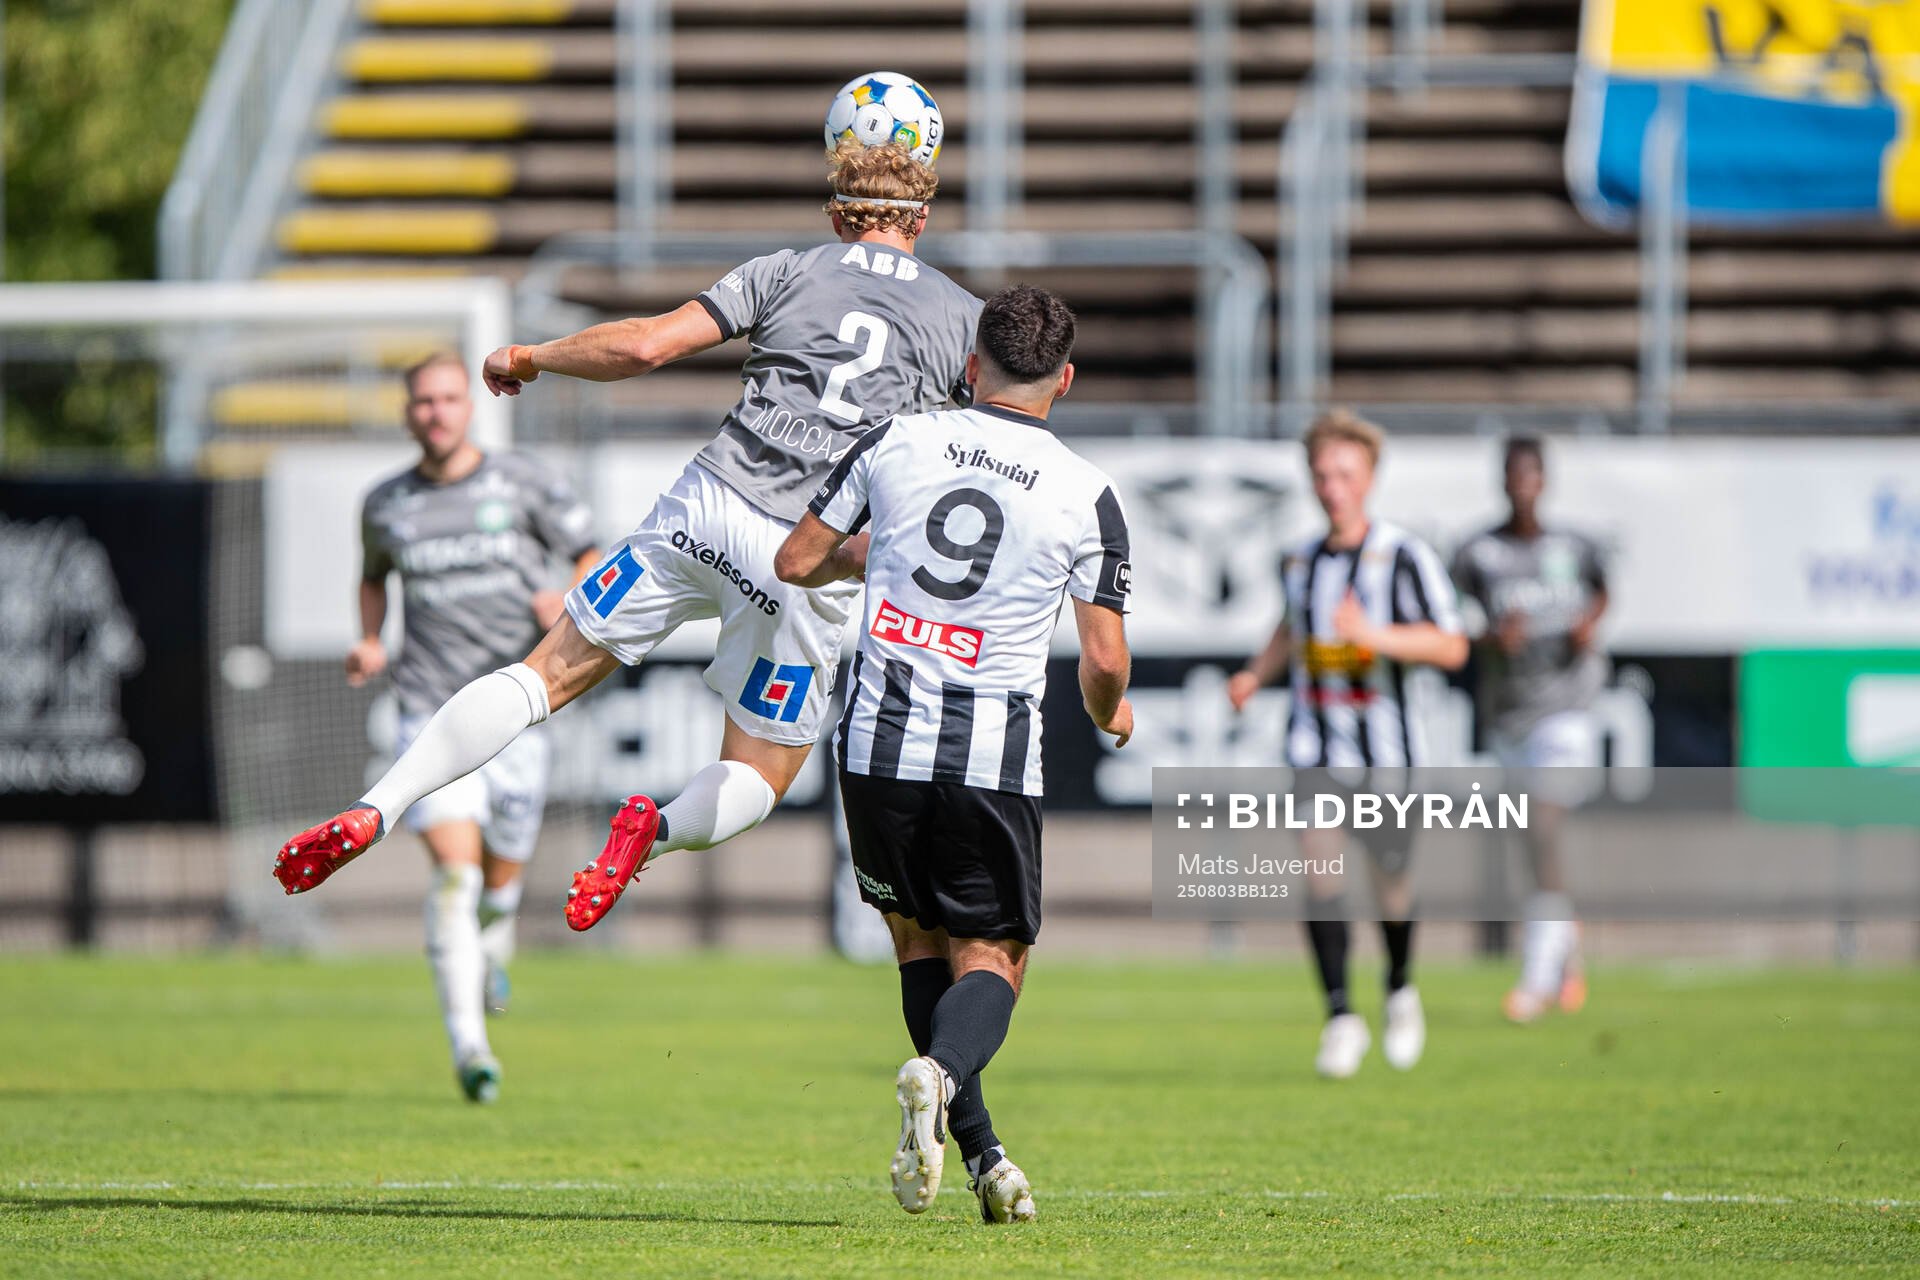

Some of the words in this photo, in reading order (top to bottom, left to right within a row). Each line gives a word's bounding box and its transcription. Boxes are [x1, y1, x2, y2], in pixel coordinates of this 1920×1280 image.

[918, 116, 939, 164] ELECT
[840, 244, 920, 282] ABB
[818, 311, 889, 424] 2
[749, 402, 858, 463] MOCCA
[944, 442, 1040, 491] Sylisufaj
[911, 487, 1005, 601] 9
[671, 530, 780, 616] axelssons
[875, 608, 979, 659] PULS
